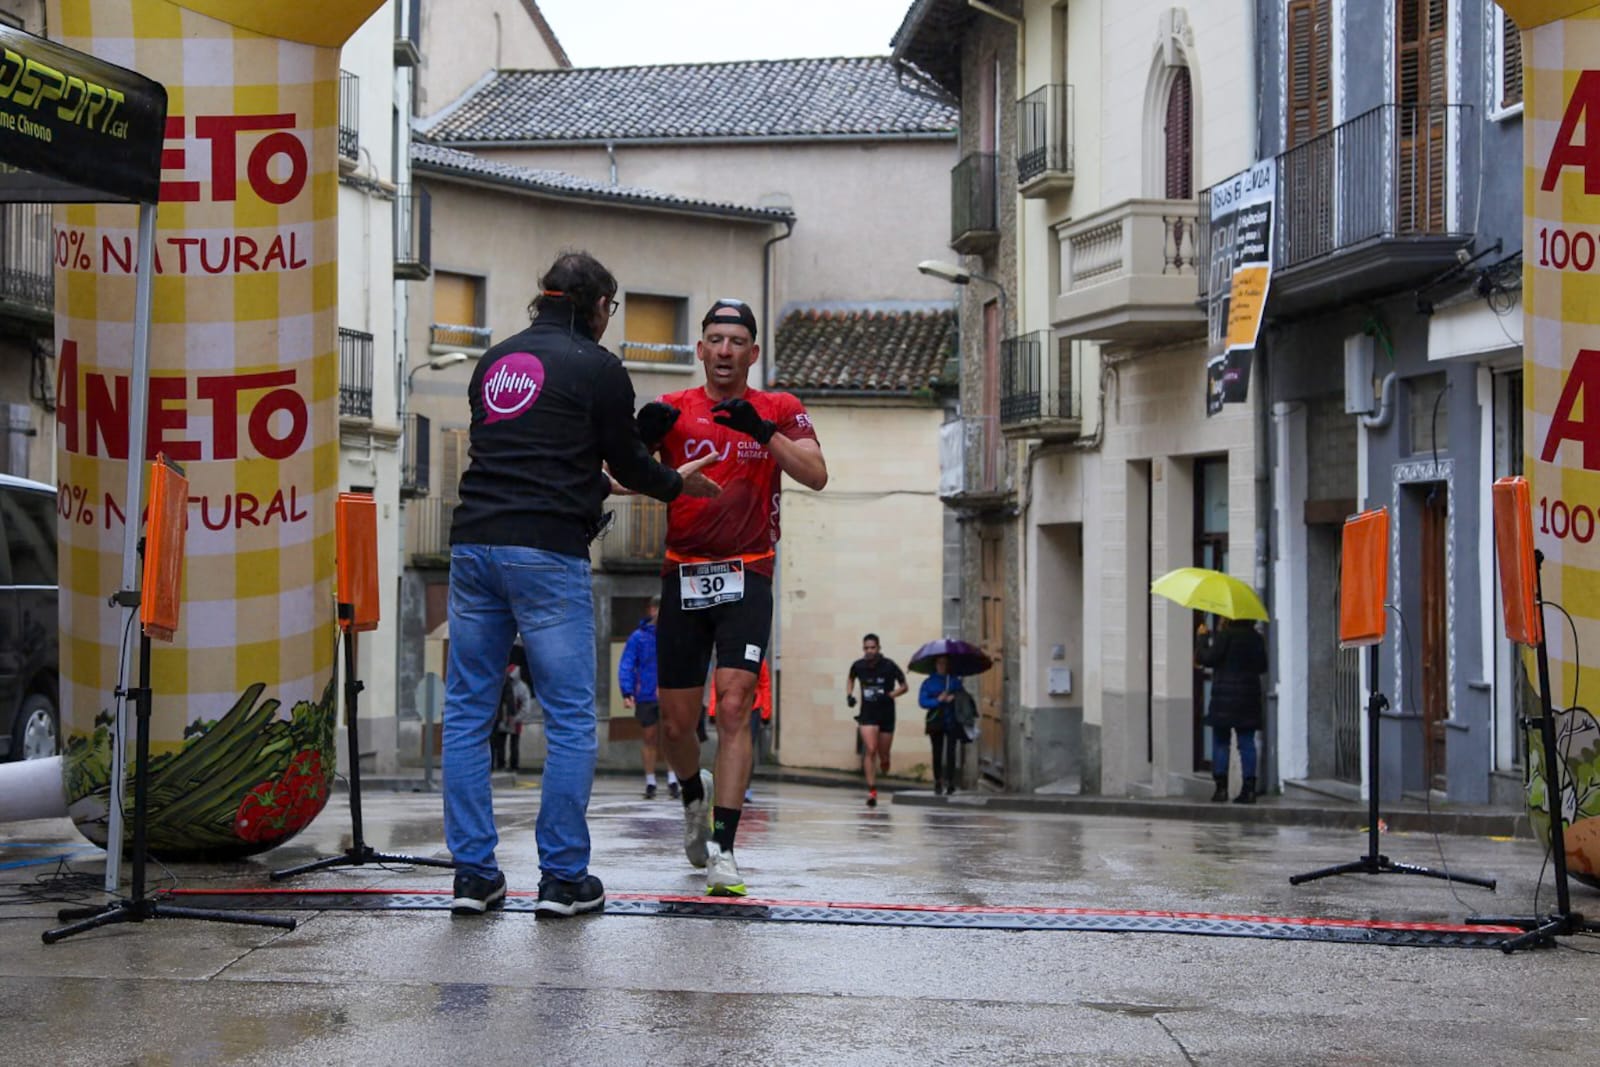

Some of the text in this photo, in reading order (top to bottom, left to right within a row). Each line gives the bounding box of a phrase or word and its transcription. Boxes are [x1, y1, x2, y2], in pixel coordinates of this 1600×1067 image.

[17, 114, 52, 143] Chrono
[158, 113, 308, 204] ETO
[55, 229, 307, 274] 0% NTURAL
[1540, 227, 1600, 272] 100
[56, 339, 308, 460] ANETO
[737, 441, 761, 450] CLUB
[58, 481, 307, 530] 0% NURAL
[1540, 496, 1600, 544] 100
[700, 576, 725, 595] 30
